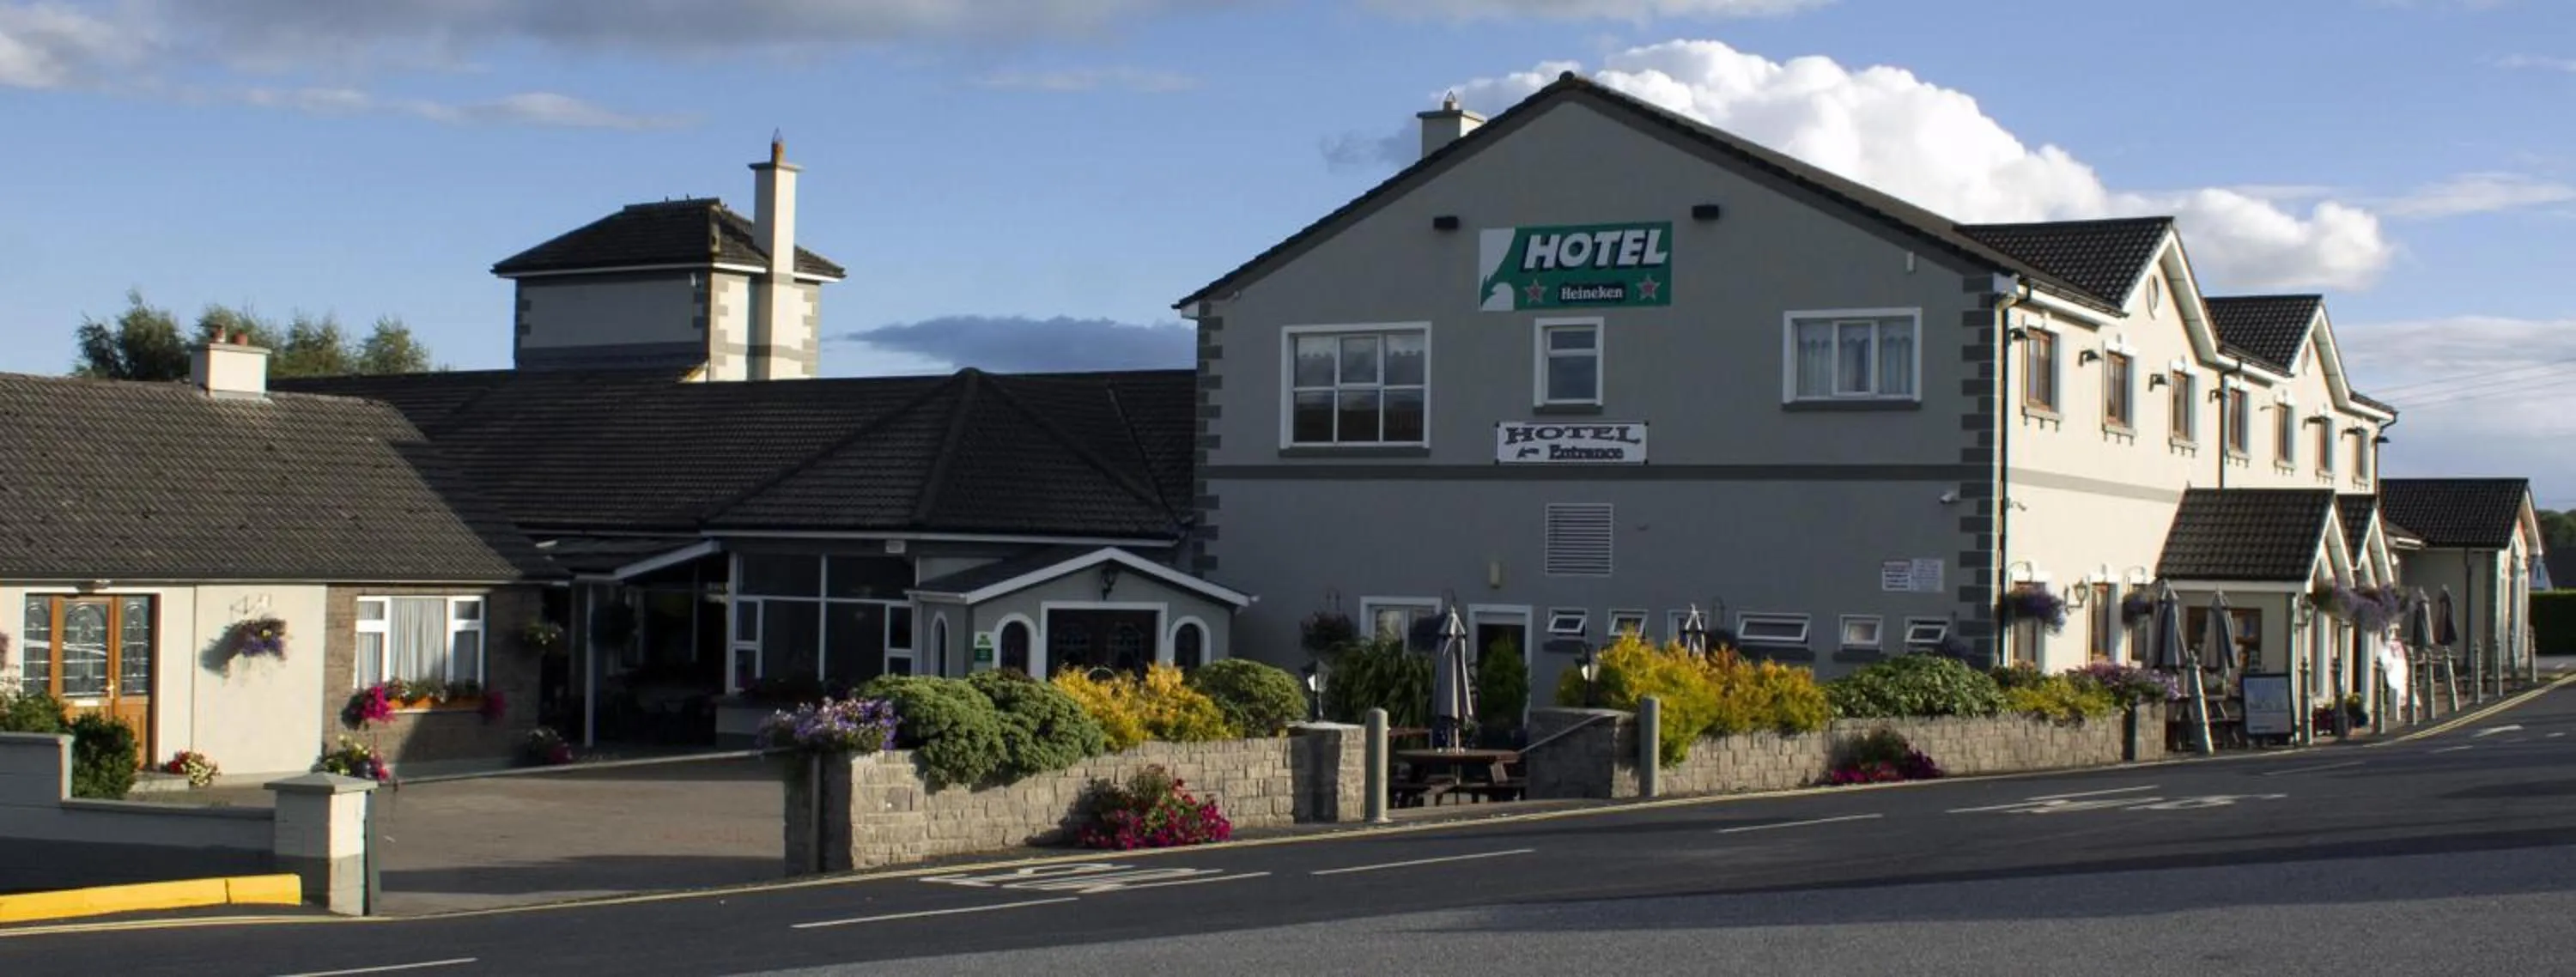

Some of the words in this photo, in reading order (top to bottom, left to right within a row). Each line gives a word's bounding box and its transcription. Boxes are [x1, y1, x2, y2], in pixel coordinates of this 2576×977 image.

[1523, 229, 1668, 270] HOTEL
[1560, 285, 1624, 300] Heineken
[1504, 426, 1641, 445] HOTEL
